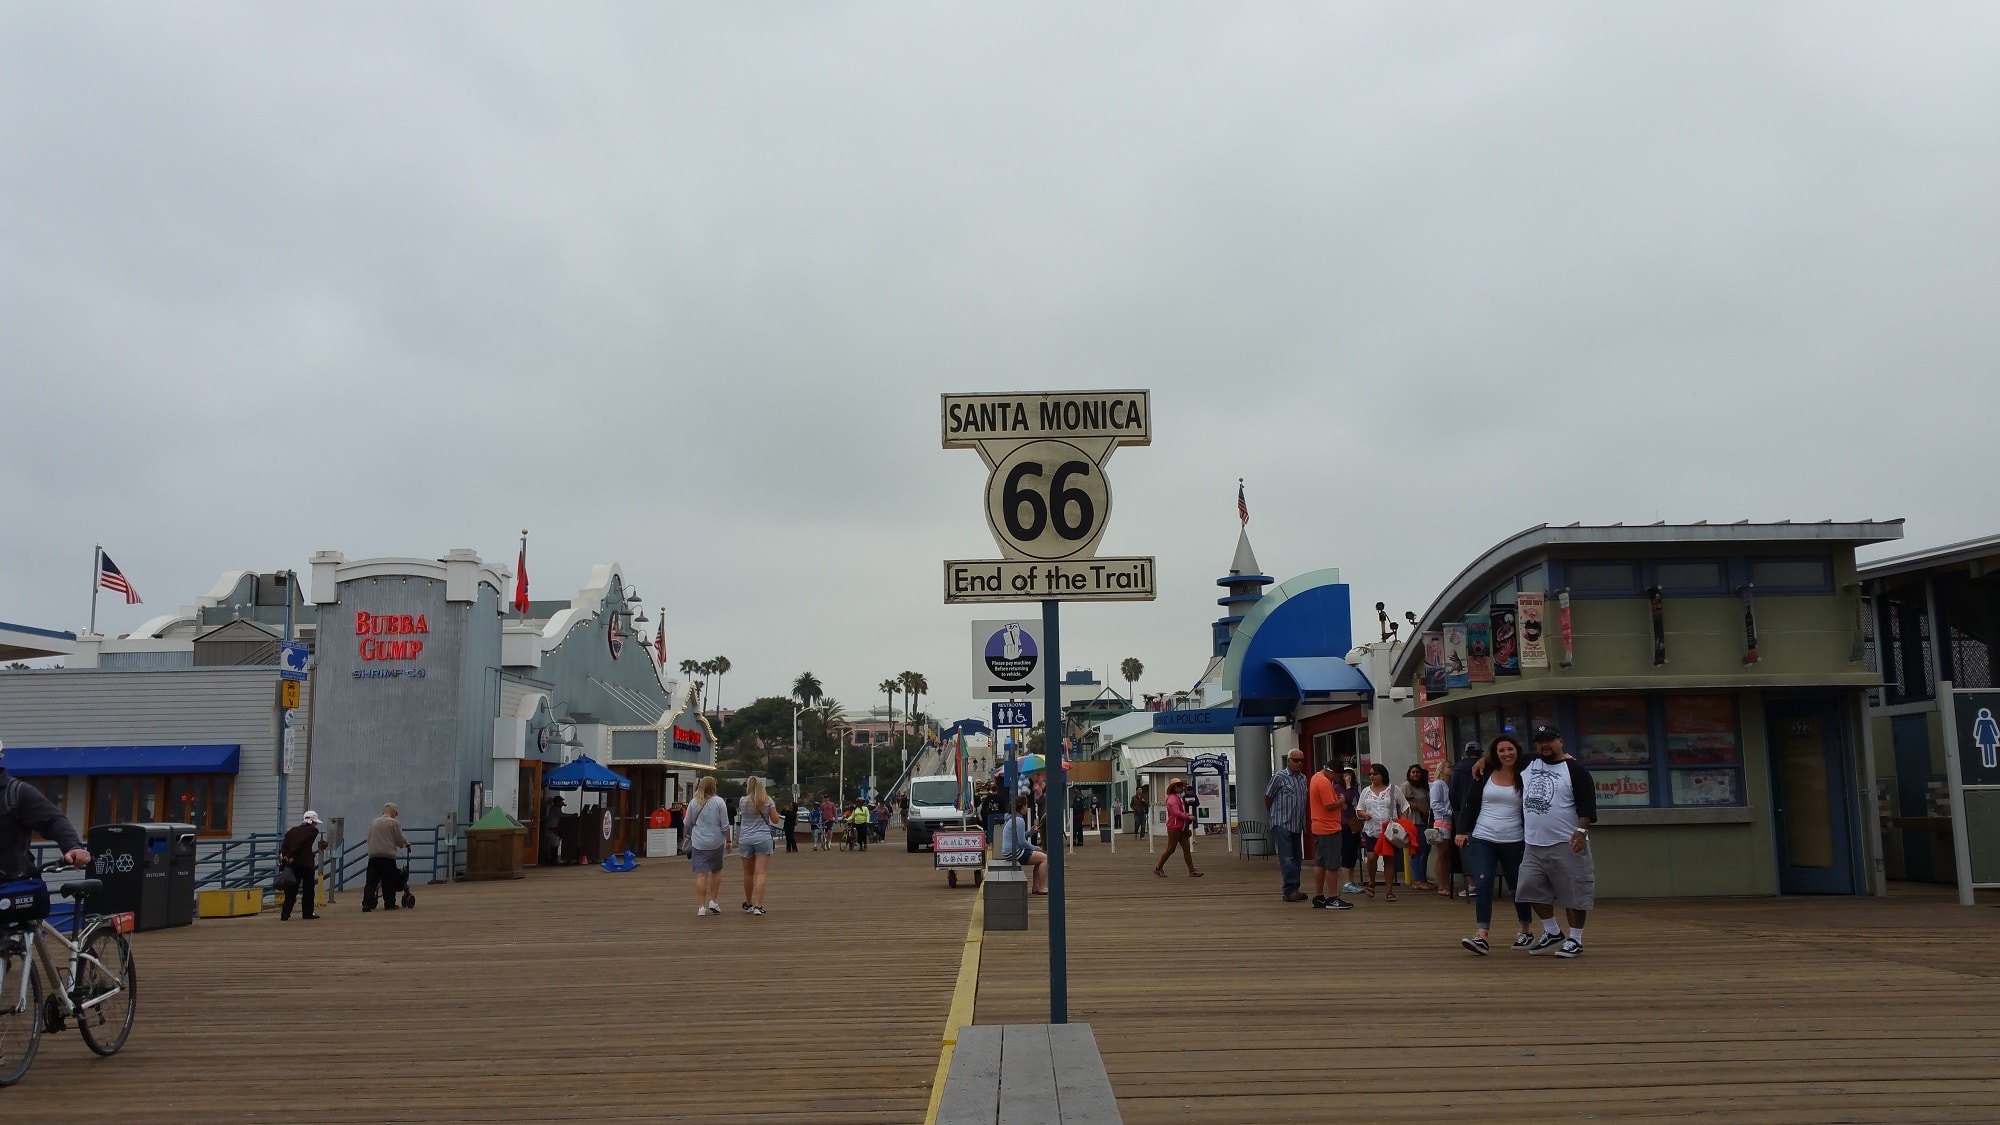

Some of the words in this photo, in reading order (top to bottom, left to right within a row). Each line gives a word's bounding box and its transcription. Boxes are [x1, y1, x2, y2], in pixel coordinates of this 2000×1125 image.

[949, 402, 1029, 433] SANTA
[1040, 400, 1142, 431] MONICA
[1002, 460, 1094, 541] 66
[954, 566, 1002, 592] End
[1011, 565, 1038, 591] of
[1045, 565, 1086, 590] the
[1089, 563, 1146, 589] Trail
[356, 610, 429, 635] BUBBA
[359, 637, 423, 661] GUMP
[352, 668, 403, 679] SHRIMP
[405, 668, 426, 678] CO
[1177, 712, 1212, 724] POLICE
[15, 896, 34, 905] BIKE
